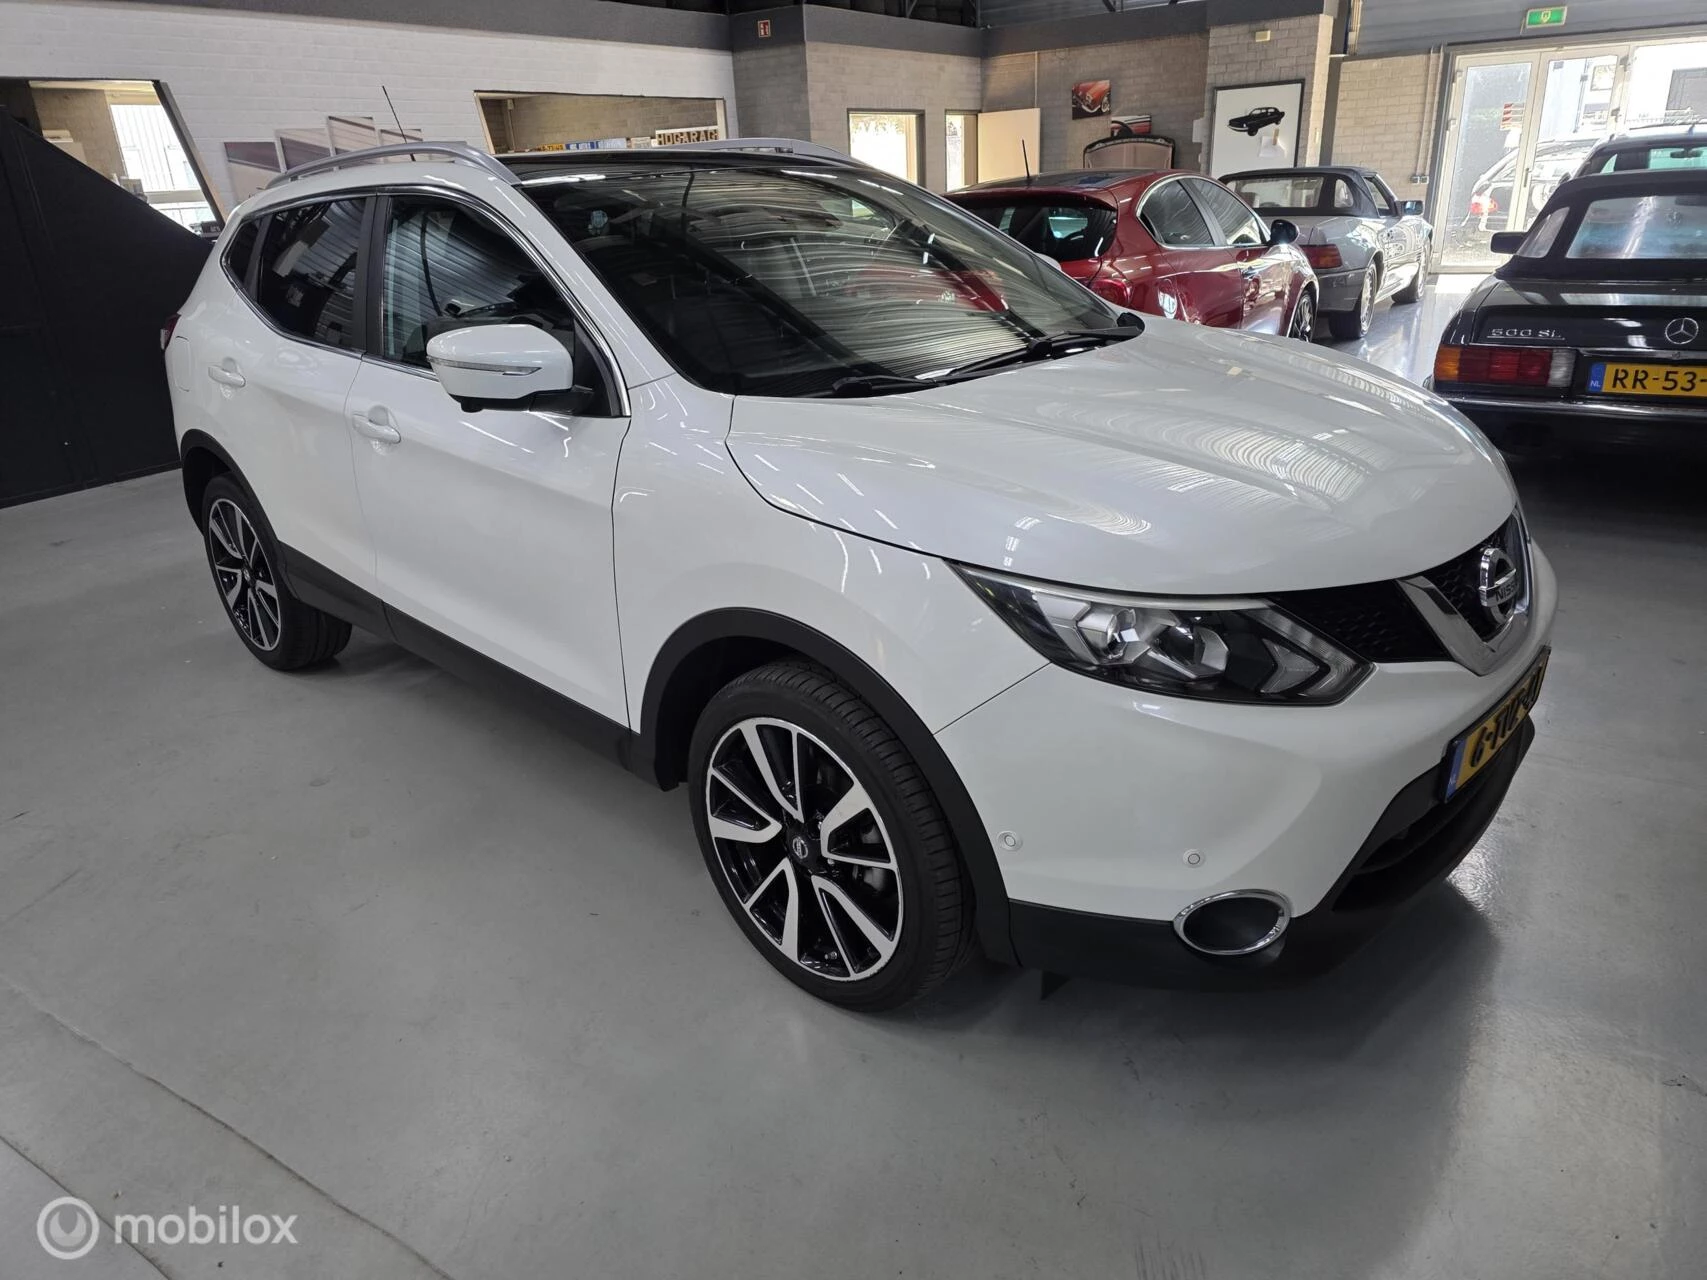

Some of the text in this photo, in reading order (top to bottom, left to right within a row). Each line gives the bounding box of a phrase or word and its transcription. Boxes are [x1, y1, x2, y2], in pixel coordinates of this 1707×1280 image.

[1491, 328, 1562, 338] 500 SL
[1590, 380, 1601, 388] NL
